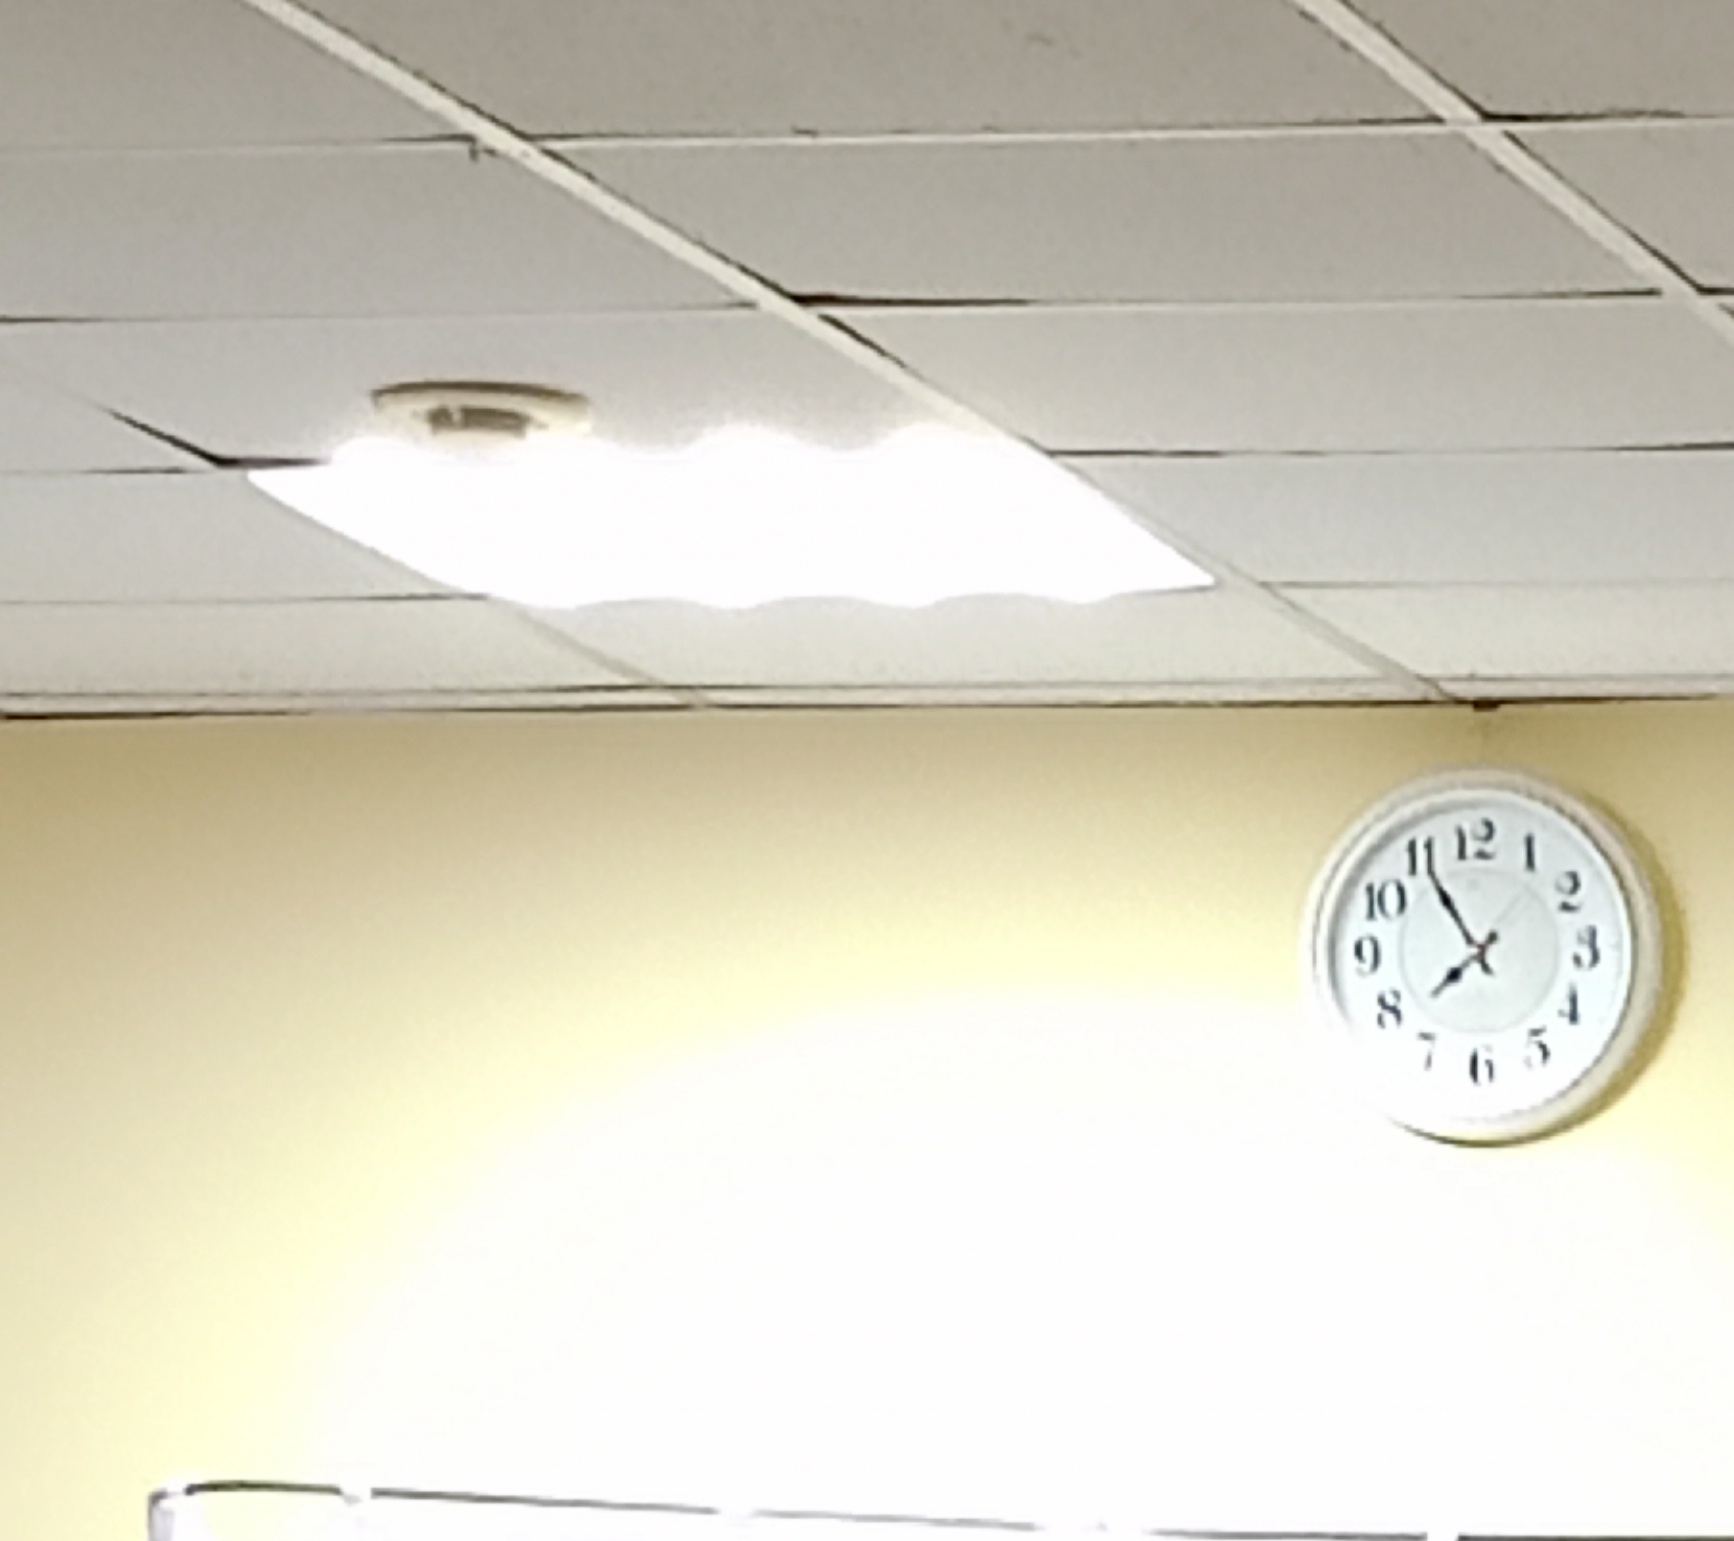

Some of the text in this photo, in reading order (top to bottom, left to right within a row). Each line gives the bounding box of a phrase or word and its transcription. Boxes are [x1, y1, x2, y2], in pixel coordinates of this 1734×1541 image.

[1406, 837, 1435, 877] 11
[1455, 818, 1496, 861] 12
[1525, 832, 1535, 871] 1
[1366, 880, 1407, 920] 10
[1555, 871, 1582, 912] 2
[1354, 935, 1381, 976] 9
[1573, 926, 1600, 969] 3
[1377, 990, 1402, 1028] 8
[1558, 983, 1579, 1024] 4
[1417, 1033, 1435, 1070] 7
[1469, 1045, 1494, 1085] 6
[1524, 1028, 1550, 1069] 5
